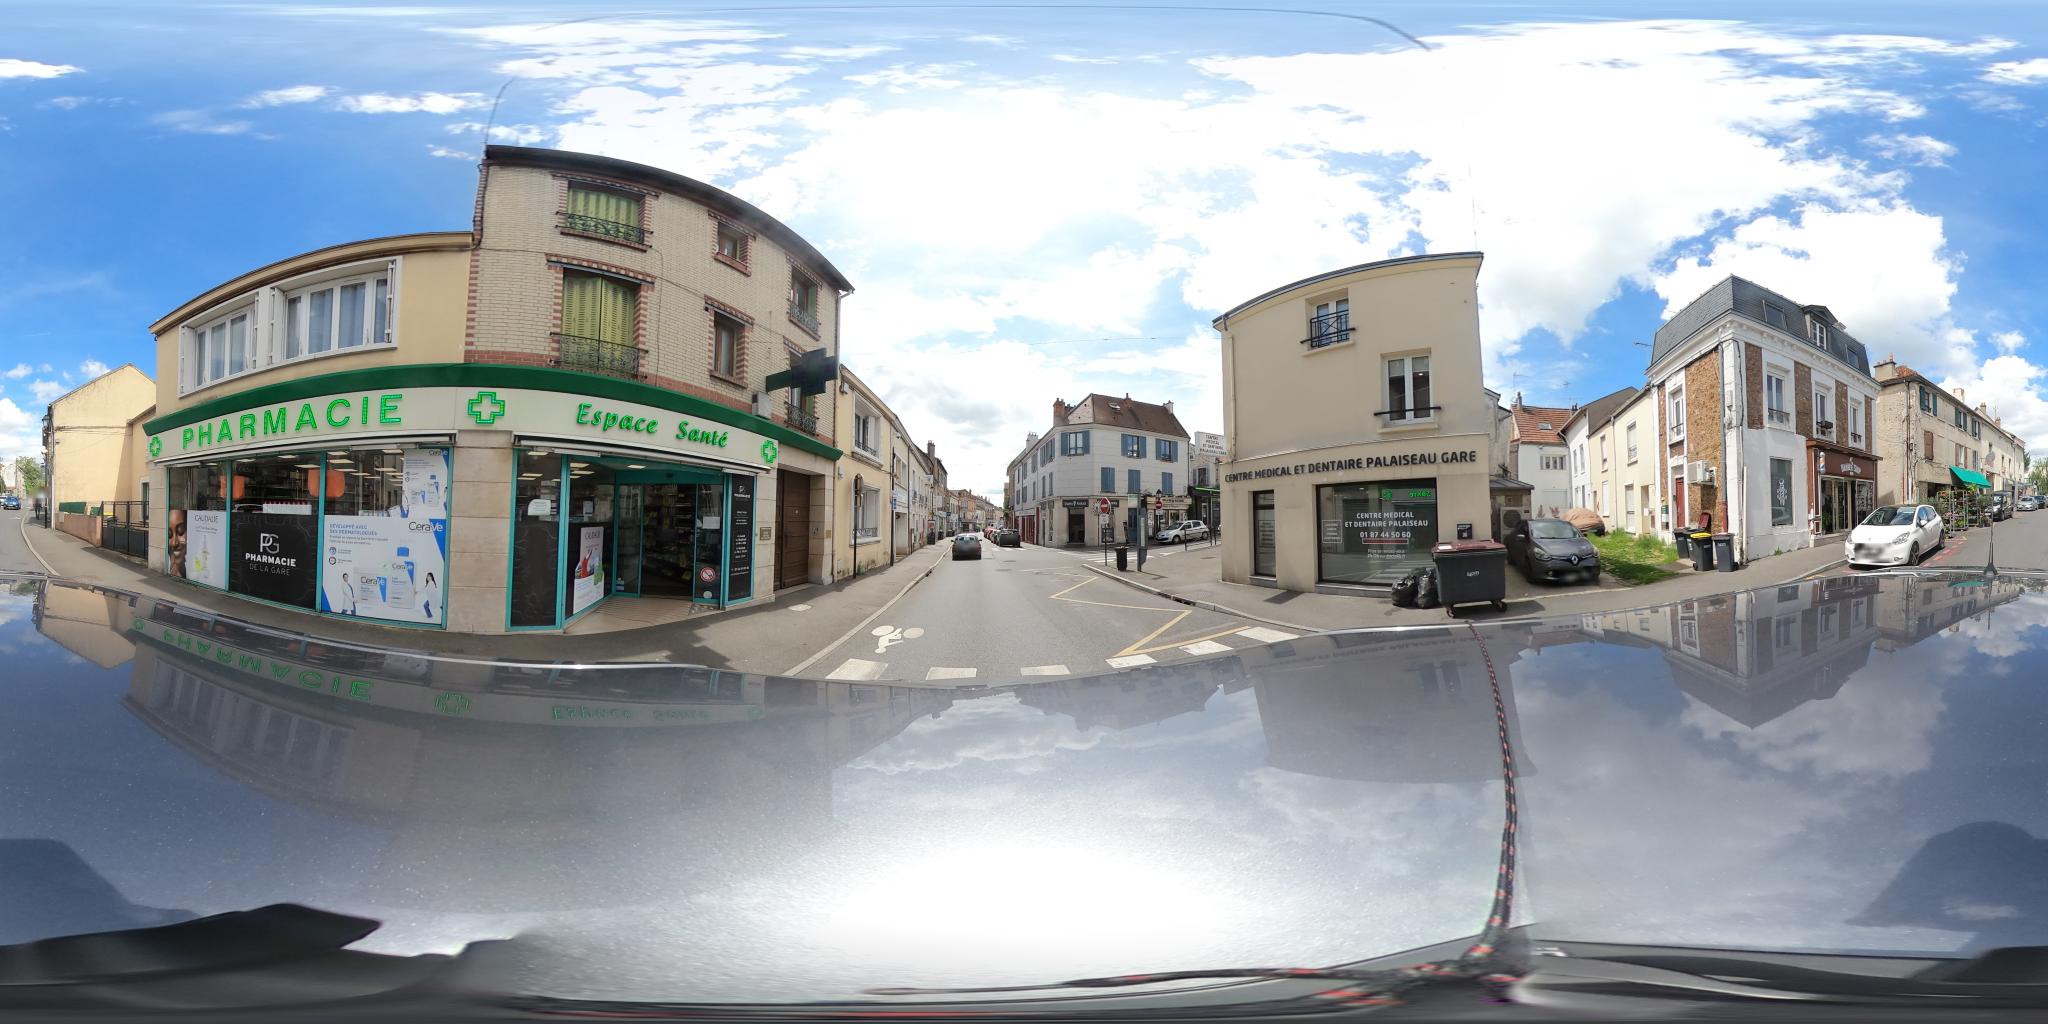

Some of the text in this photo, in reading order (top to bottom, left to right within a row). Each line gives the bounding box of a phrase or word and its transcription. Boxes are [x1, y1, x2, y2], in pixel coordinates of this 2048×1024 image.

[182, 393, 404, 450] PHARMACIE
[576, 401, 730, 448] Espace Santé
[1224, 450, 1477, 482] CENTRE MEDICAL ET DENTAIRE PALAISEAU GARE
[1383, 511, 1415, 519] MEDICAL
[408, 521, 443, 532] CeraVe
[1353, 520, 1387, 528] DENTAIRE
[1388, 519, 1429, 527] PALAISEAU
[245, 552, 297, 567] PHARMACIE
[249, 563, 291, 576] DE LA GARE
